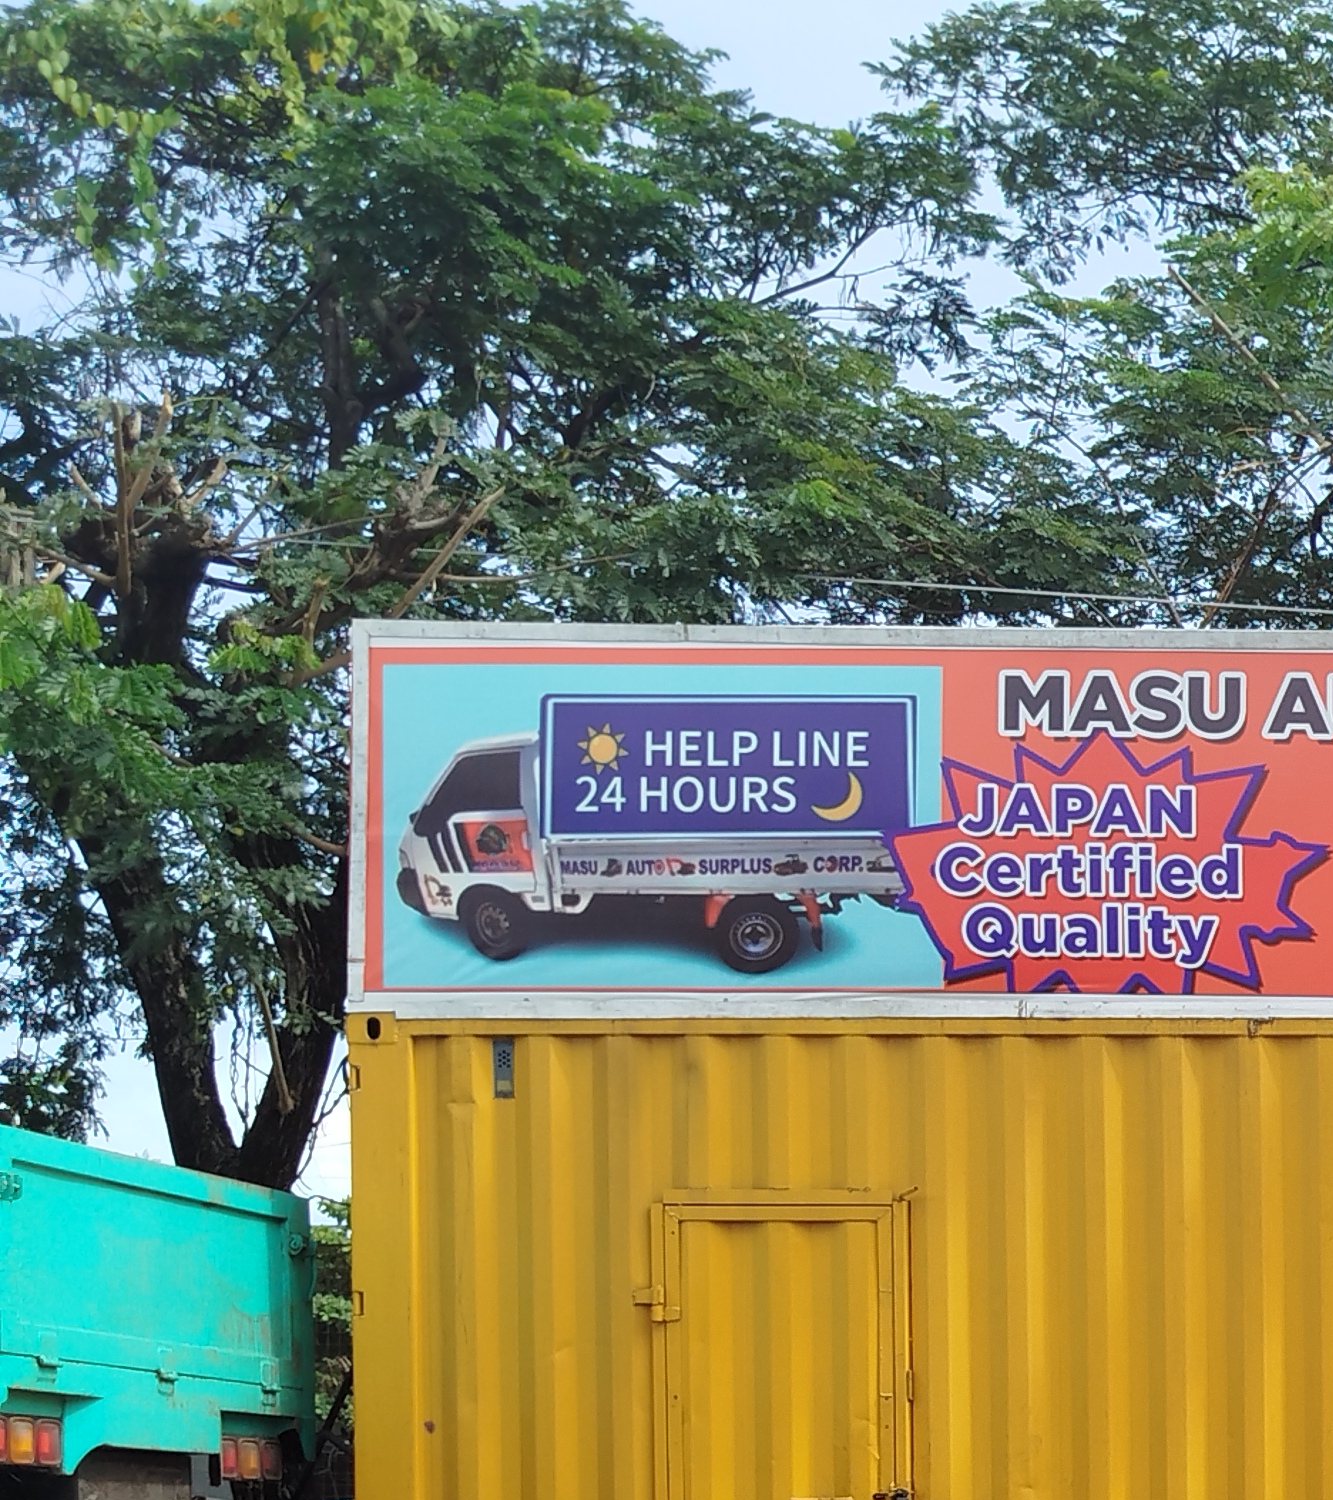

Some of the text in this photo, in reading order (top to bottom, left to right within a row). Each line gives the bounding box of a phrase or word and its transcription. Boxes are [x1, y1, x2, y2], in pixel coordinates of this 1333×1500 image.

[1002, 671, 1243, 737] MASU
[645, 729, 870, 768] HELP LINE
[574, 775, 797, 814] 24 HOURS
[960, 784, 1196, 837] JAPAN
[561, 859, 598, 875] MASU
[698, 857, 773, 875] SURPLUS
[937, 844, 1242, 898] Certified
[963, 904, 1216, 967] Quality
